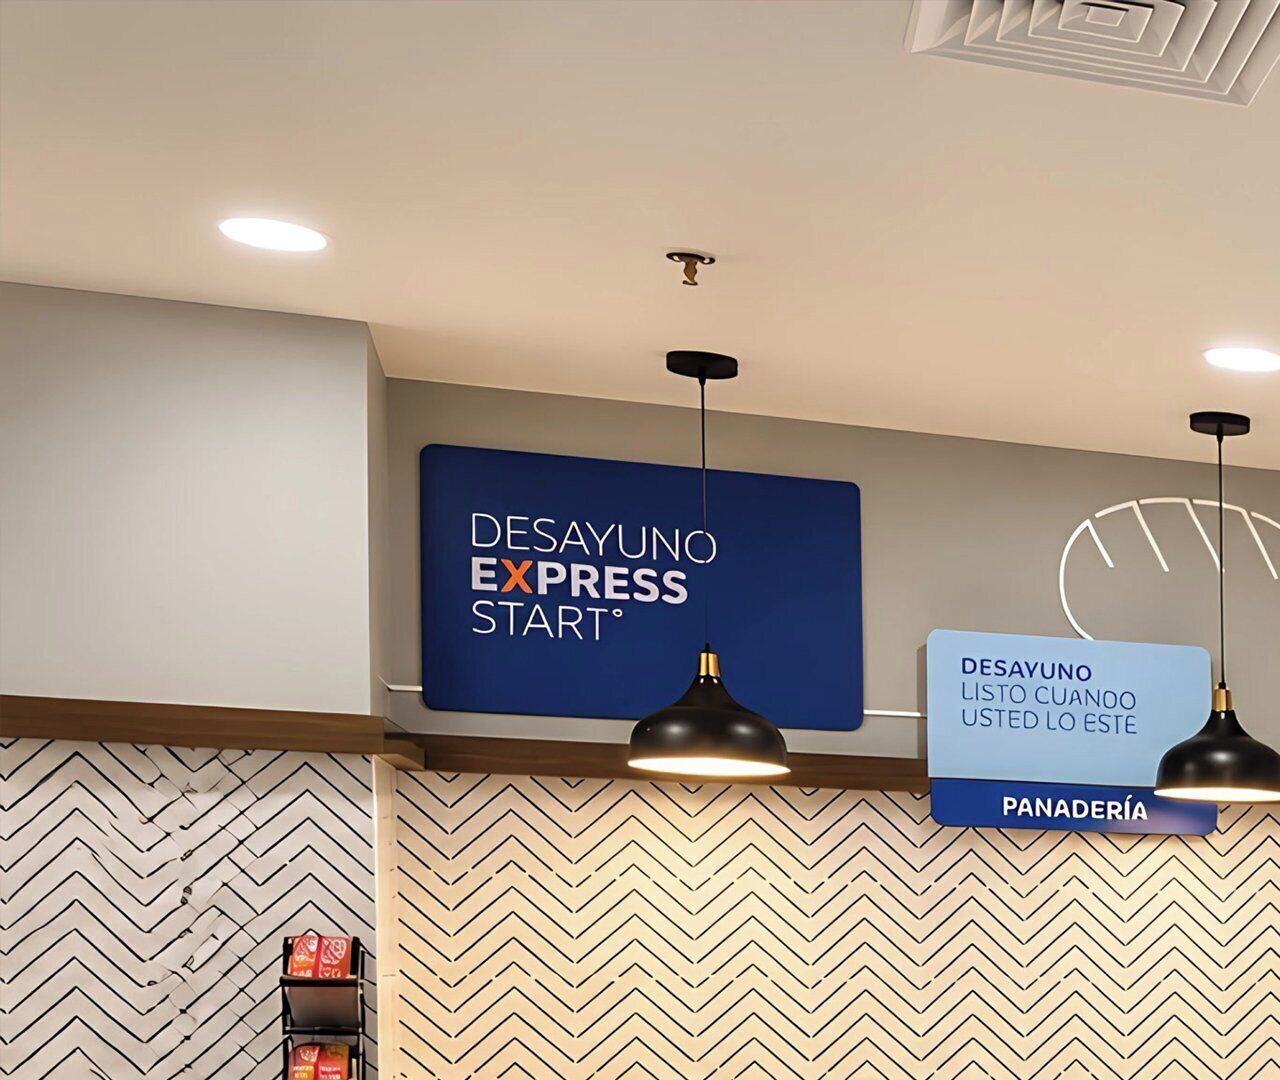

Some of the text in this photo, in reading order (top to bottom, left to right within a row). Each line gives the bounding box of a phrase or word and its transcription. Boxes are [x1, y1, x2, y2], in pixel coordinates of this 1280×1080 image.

[471, 512, 717, 564] DESAYUNO
[471, 556, 689, 605] EXPRESS
[961, 656, 1092, 682] DESAYUNO
[961, 681, 1137, 711] LISTO CUANDO
[961, 708, 1138, 735] USTED LO ESTE
[1002, 794, 1148, 821] PANADERÍA
